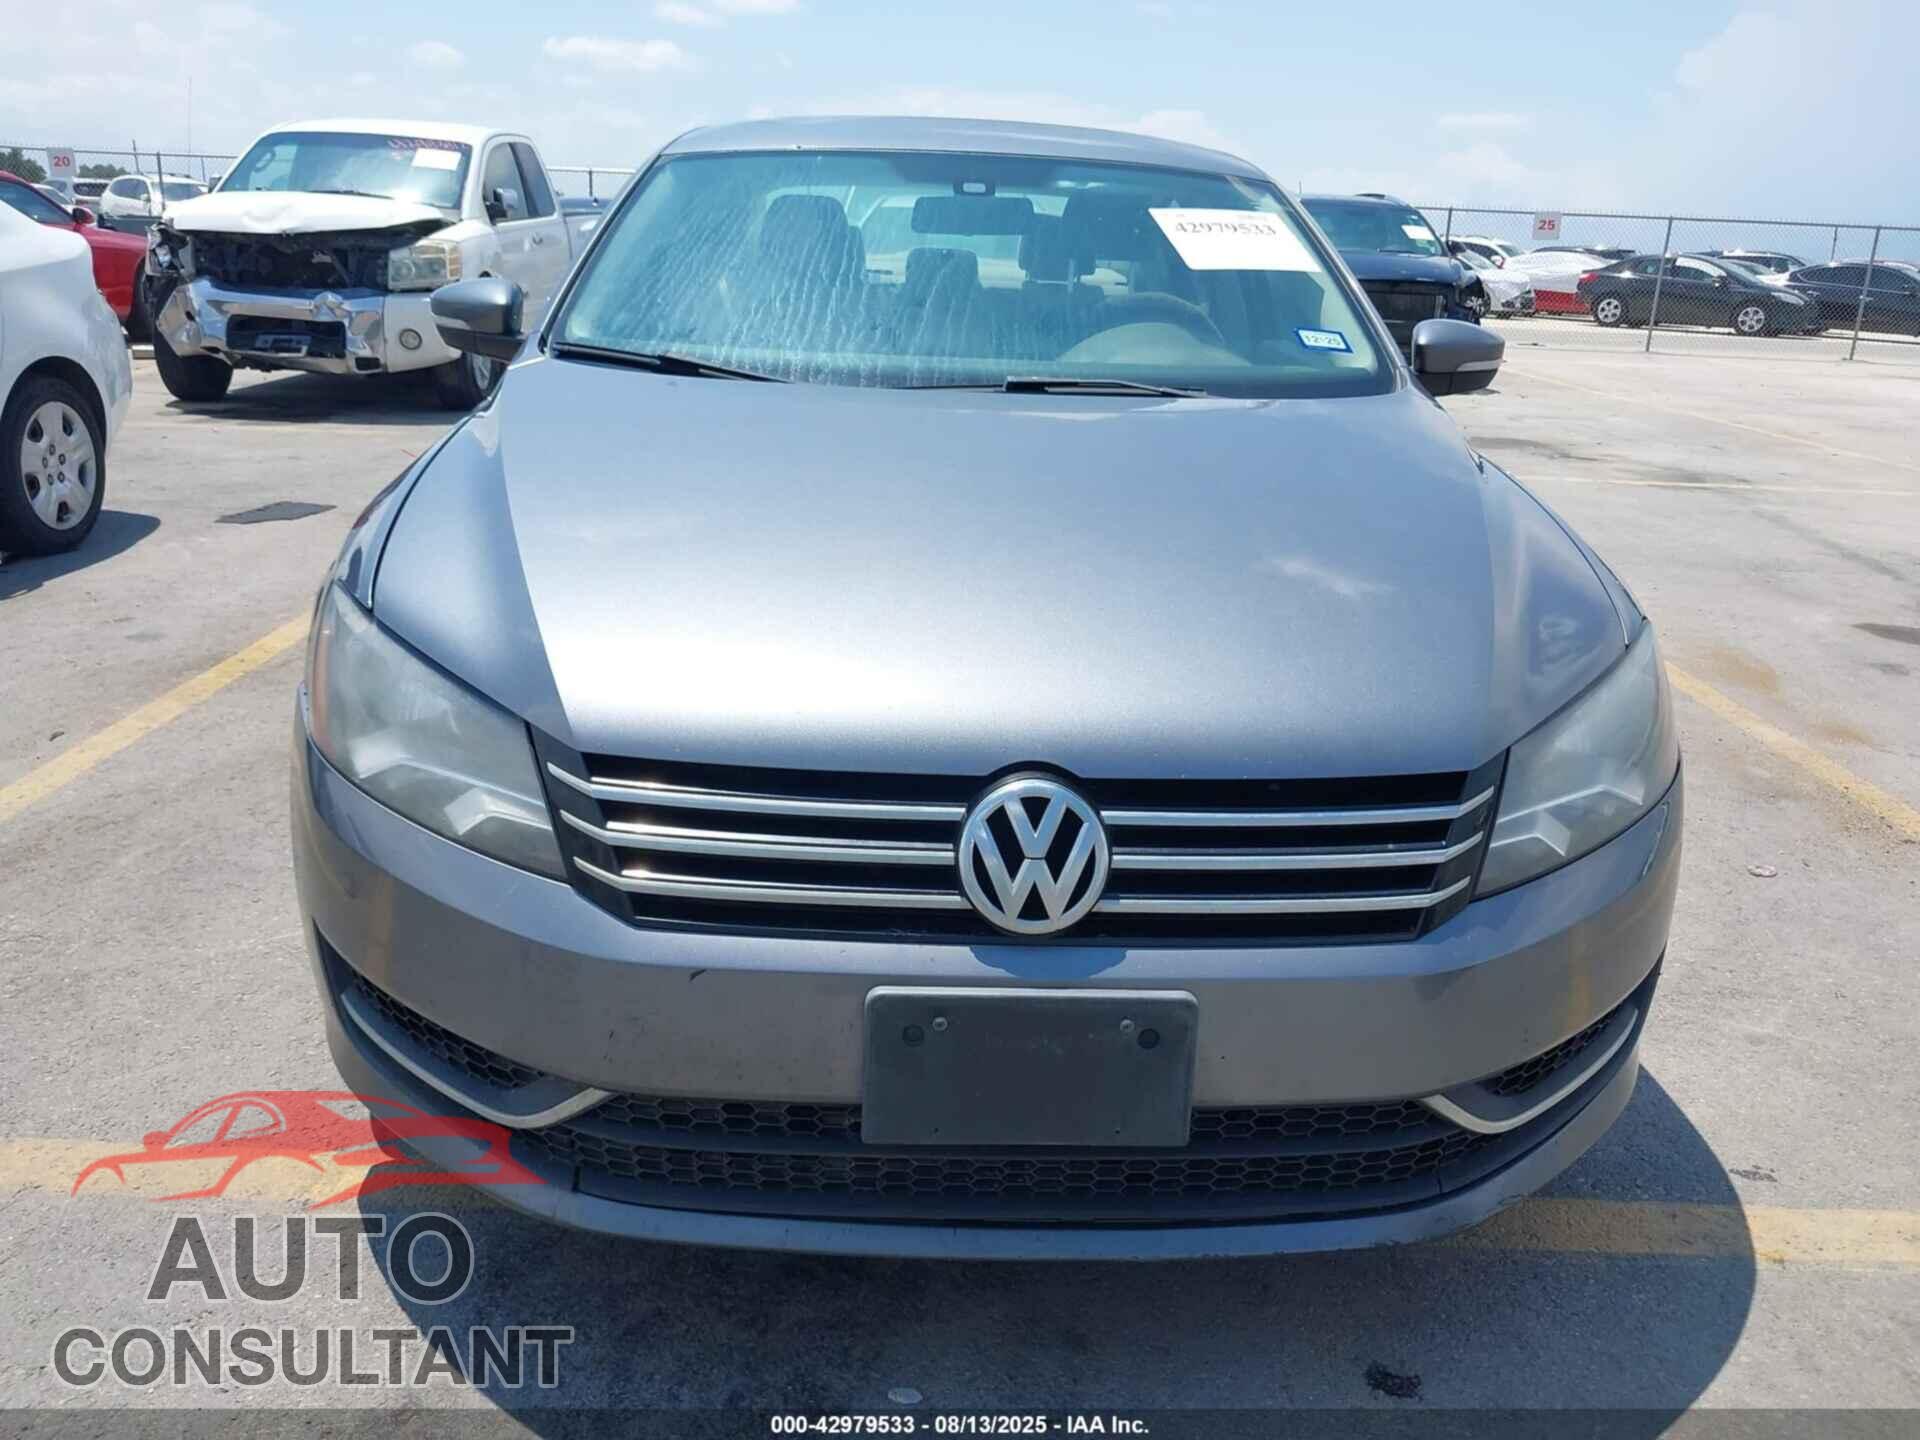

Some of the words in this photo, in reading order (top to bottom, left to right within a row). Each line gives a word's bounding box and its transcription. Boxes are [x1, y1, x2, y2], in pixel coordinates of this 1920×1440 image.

[53, 156, 70, 167] 20
[1176, 222, 1277, 235] 42979533
[1538, 219, 1555, 230] 25
[969, 789, 1103, 927] VW
